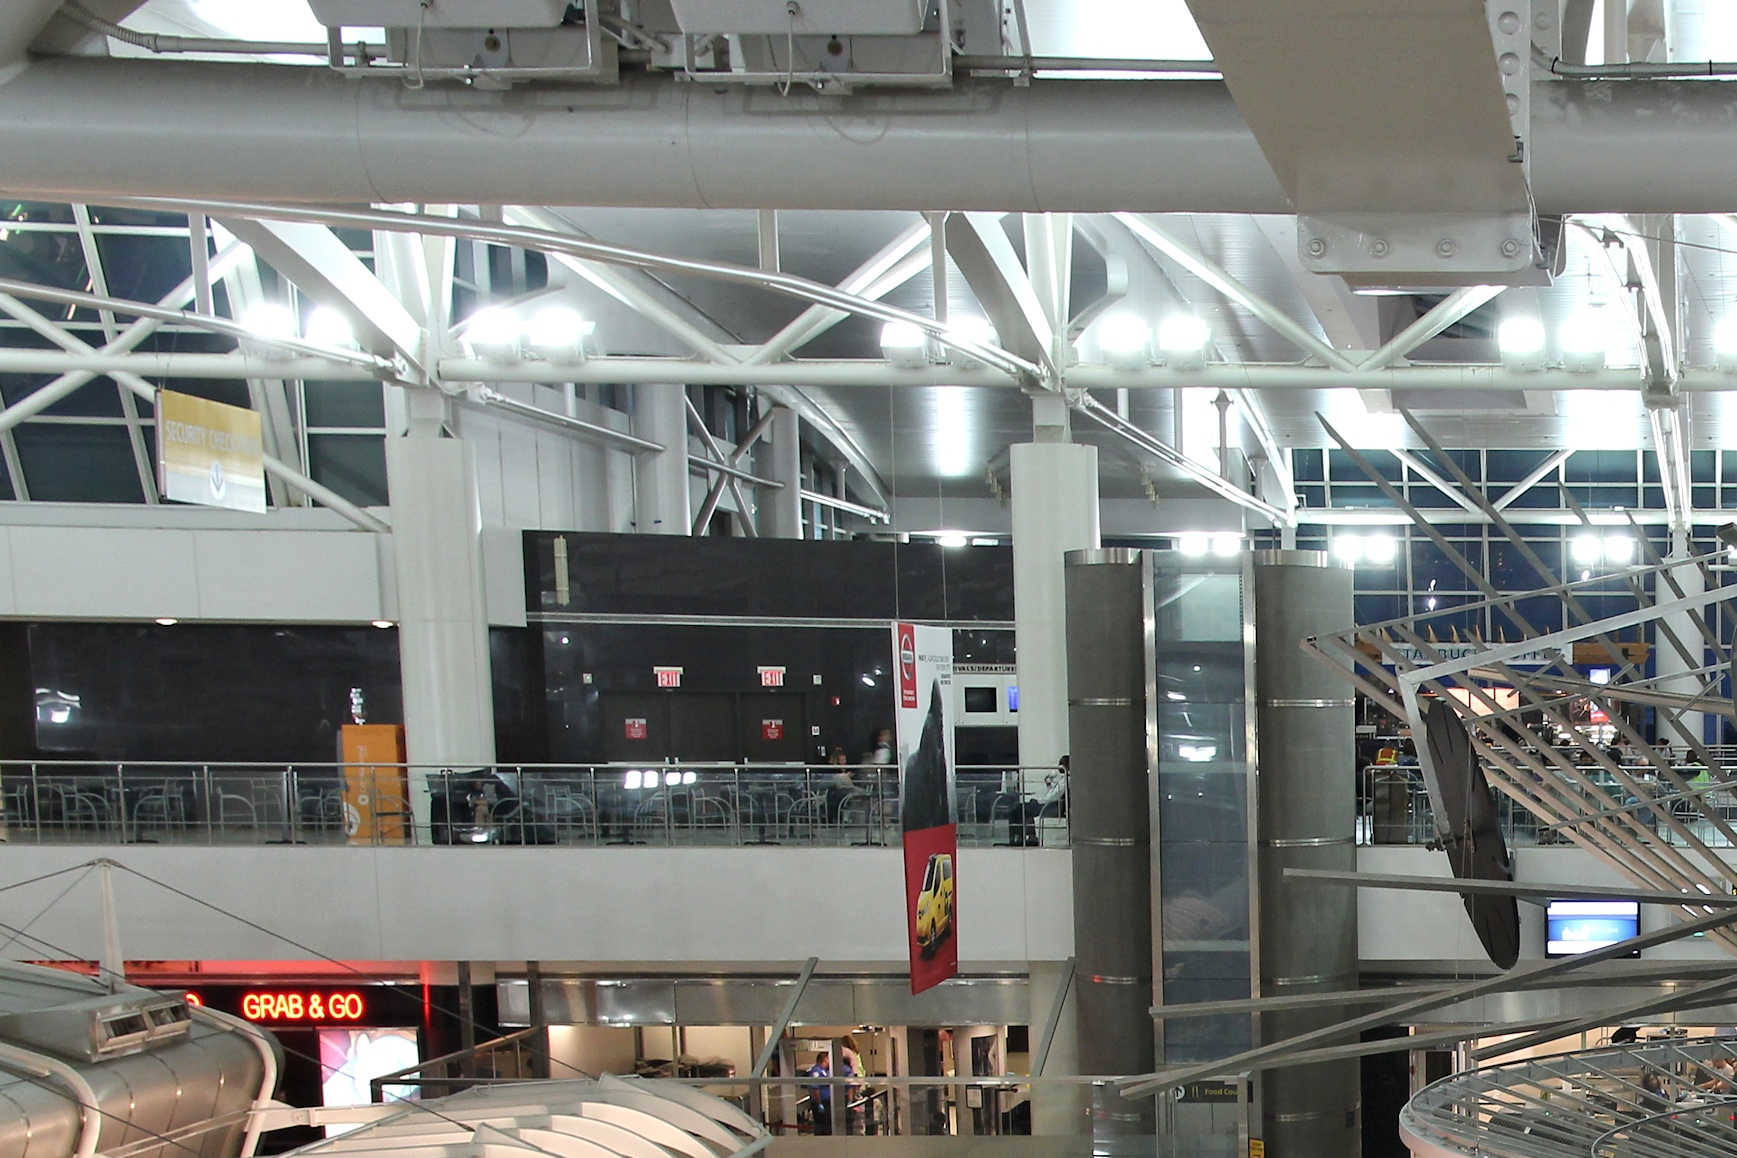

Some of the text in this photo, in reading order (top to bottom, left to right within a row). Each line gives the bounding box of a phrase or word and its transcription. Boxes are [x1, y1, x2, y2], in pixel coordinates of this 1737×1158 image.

[661, 671, 679, 685] EXIT
[764, 671, 783, 685] EXIT
[243, 994, 362, 1019] GRAB & GO
